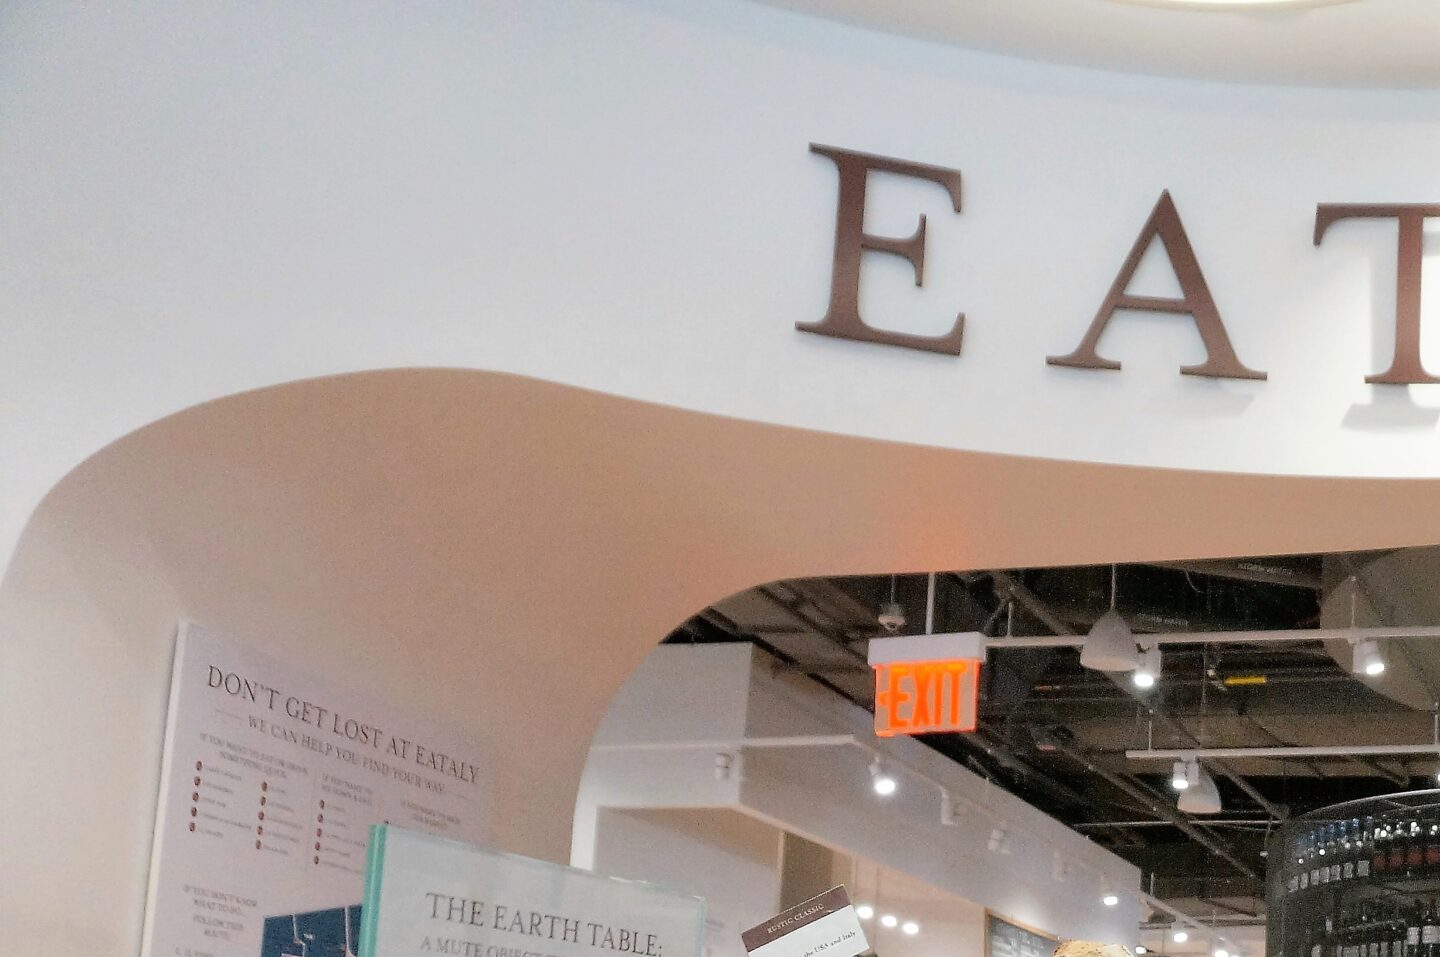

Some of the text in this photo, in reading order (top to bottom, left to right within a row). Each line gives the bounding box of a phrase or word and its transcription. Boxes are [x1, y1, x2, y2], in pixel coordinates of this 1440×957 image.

[208, 665, 480, 784] DON'T GET LOST AT EATALY
[889, 663, 966, 728] EXIT
[249, 715, 446, 794] WE CAN HELP YOU FIND YOUR WAY
[419, 935, 432, 951] A
[425, 892, 663, 957] THE EARTH TABLE:
[767, 903, 825, 935] RUSTIC CLASSIC
[814, 943, 829, 953] USA
[830, 936, 841, 948] and
[842, 931, 856, 942] Italy
